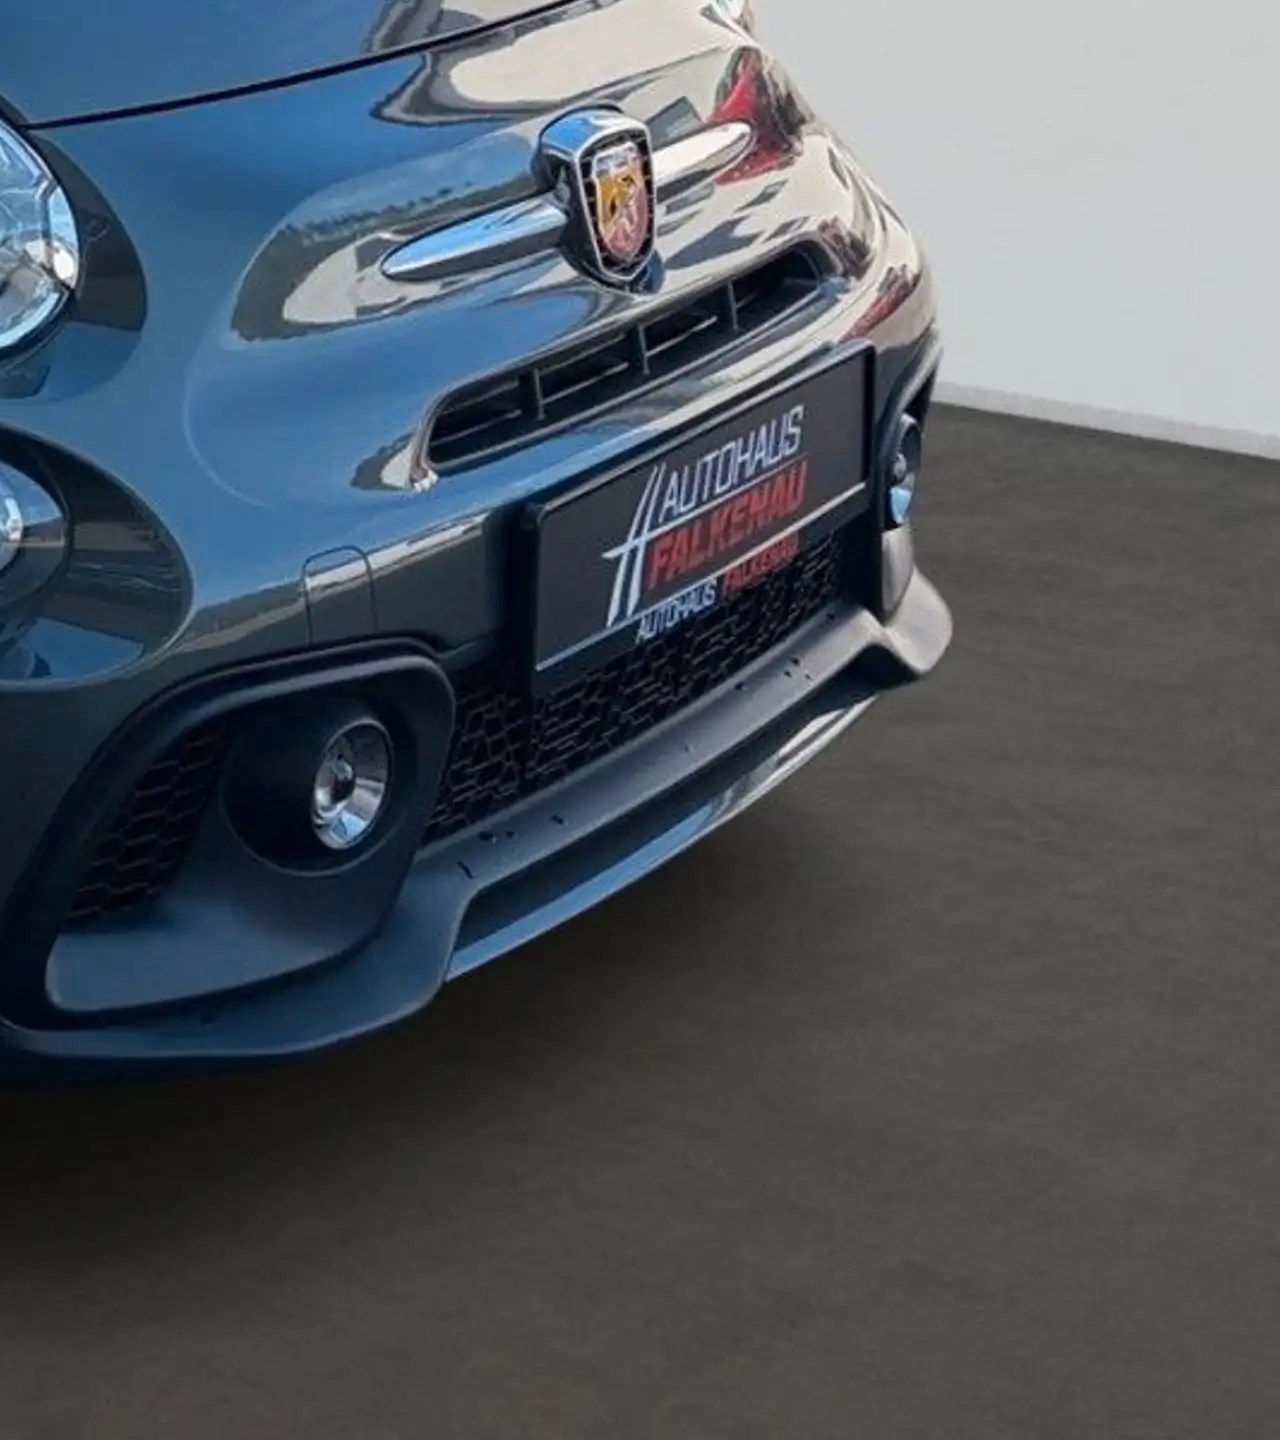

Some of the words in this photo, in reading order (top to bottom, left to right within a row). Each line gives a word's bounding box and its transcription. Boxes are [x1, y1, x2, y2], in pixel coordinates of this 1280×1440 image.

[659, 404, 804, 523] AUTOHAUS
[649, 463, 807, 588] FALKENAU
[636, 578, 717, 642] AUTOHAUS
